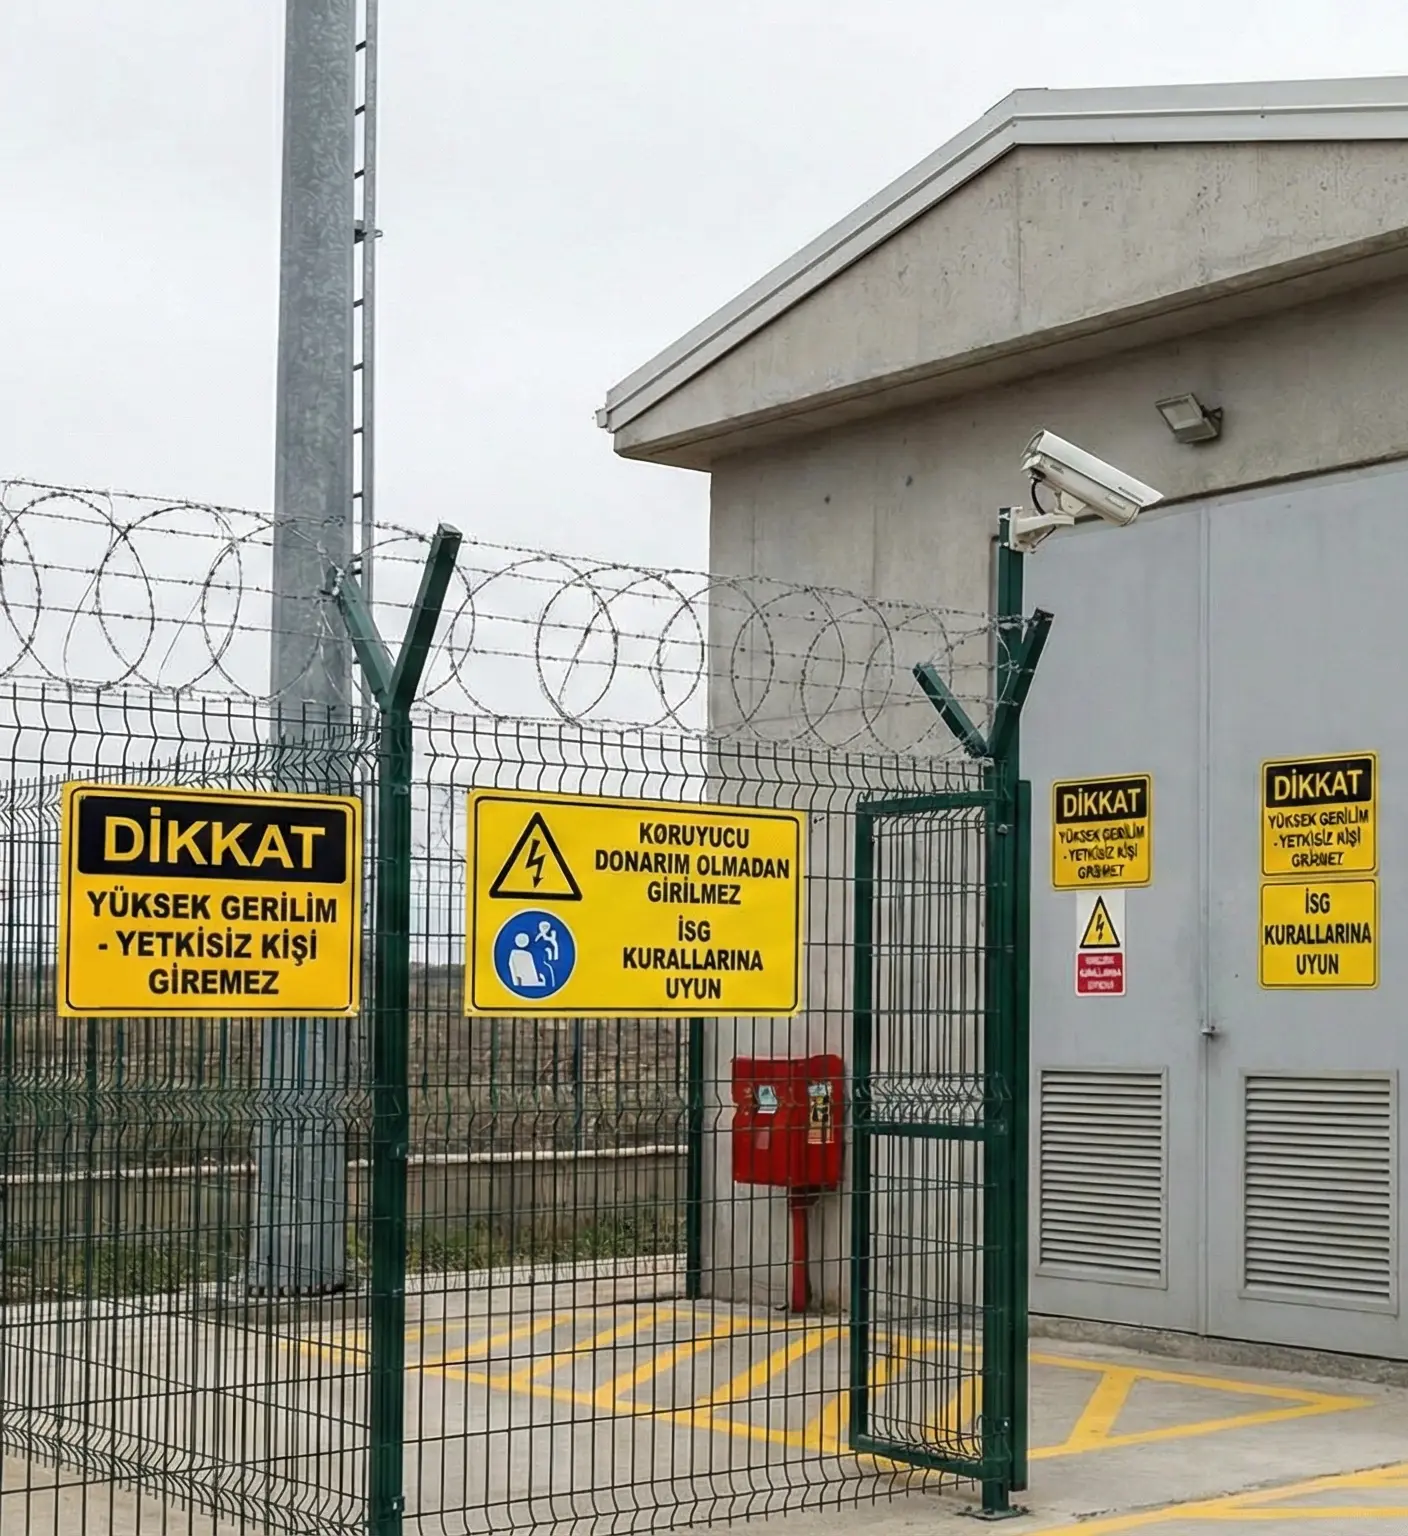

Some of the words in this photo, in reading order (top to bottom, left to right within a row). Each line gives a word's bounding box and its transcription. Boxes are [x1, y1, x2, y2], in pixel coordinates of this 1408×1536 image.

[1274, 768, 1364, 801] DİKKAT
[1062, 787, 1142, 818] DİKKAT
[103, 805, 326, 869] DİKKAT
[595, 849, 690, 875] DONARIM
[696, 854, 790, 879] OLMADAN
[87, 885, 211, 920] YÜKSEK
[221, 891, 337, 923] GERİLİM
[647, 875, 742, 905] GİRİLMEZ
[1305, 887, 1331, 914] İSG
[678, 915, 711, 942] İSG
[1264, 922, 1372, 946] KURALLARINA
[115, 926, 252, 959] YETKİSİZ
[261, 930, 317, 967] KİŞİ
[622, 947, 764, 971] KURALLARINA
[1296, 953, 1340, 975] UYUN
[147, 963, 280, 996] GİREMEZ
[666, 977, 722, 999] UYUN
